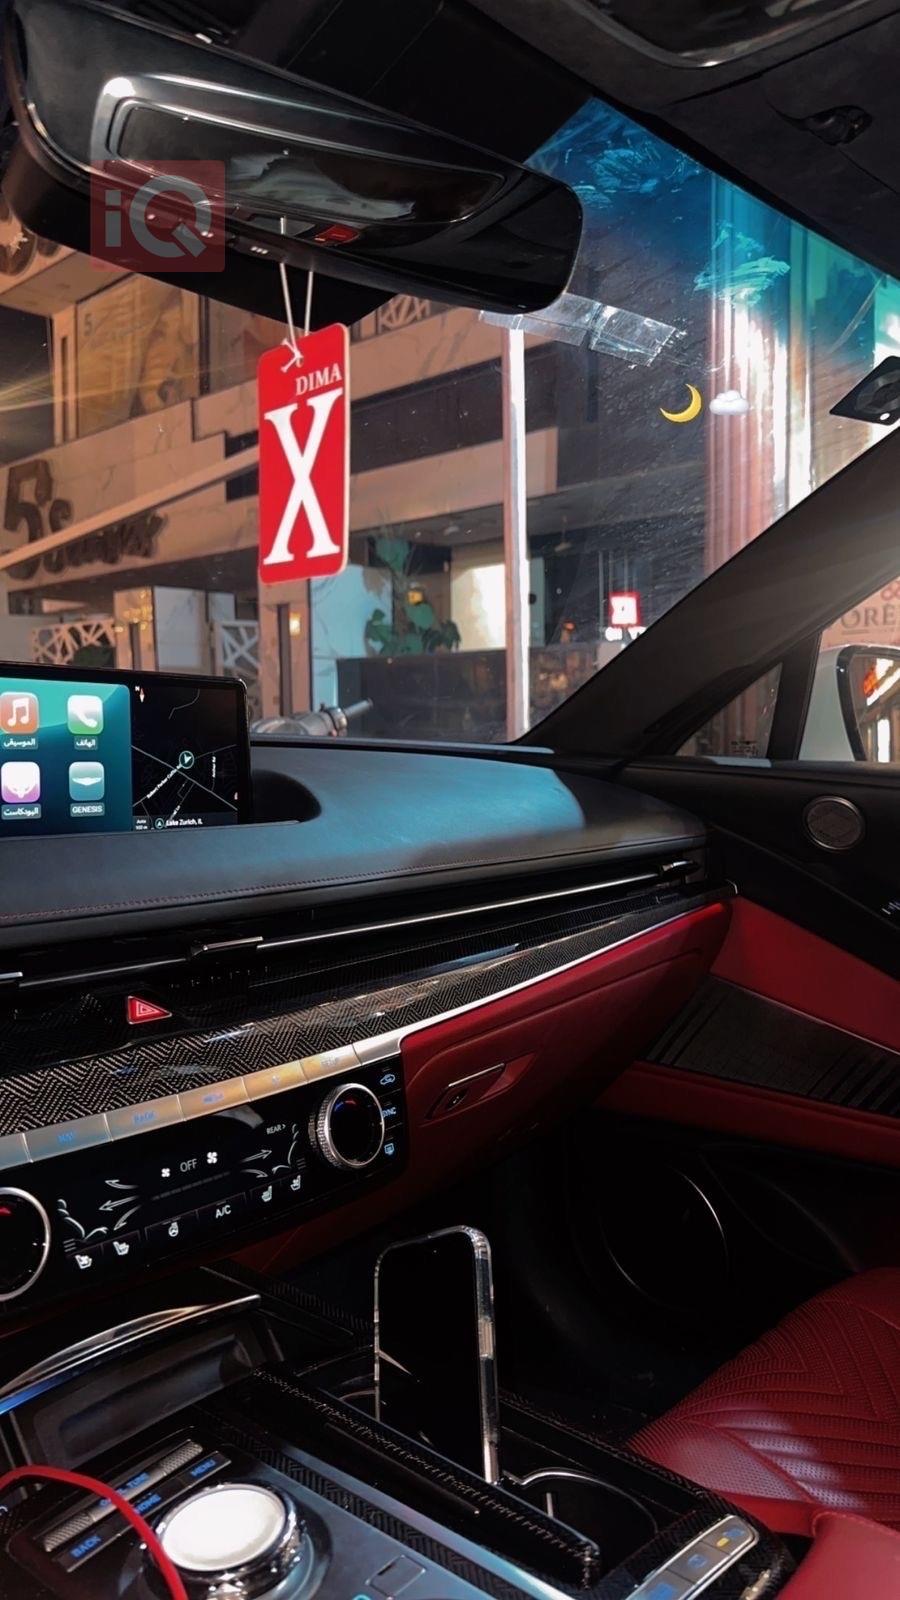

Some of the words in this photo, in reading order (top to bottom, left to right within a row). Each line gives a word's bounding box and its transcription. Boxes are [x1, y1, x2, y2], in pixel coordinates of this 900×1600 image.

[295, 363, 343, 396] DIMA
[263, 387, 344, 566] X
[71, 805, 103, 815] GENESIS
[266, 1123, 282, 1135] REAR
[179, 1158, 198, 1173] OFF
[215, 1204, 232, 1219] A/C
[190, 1459, 216, 1477] MENU
[71, 1535, 101, 1558] BACK
